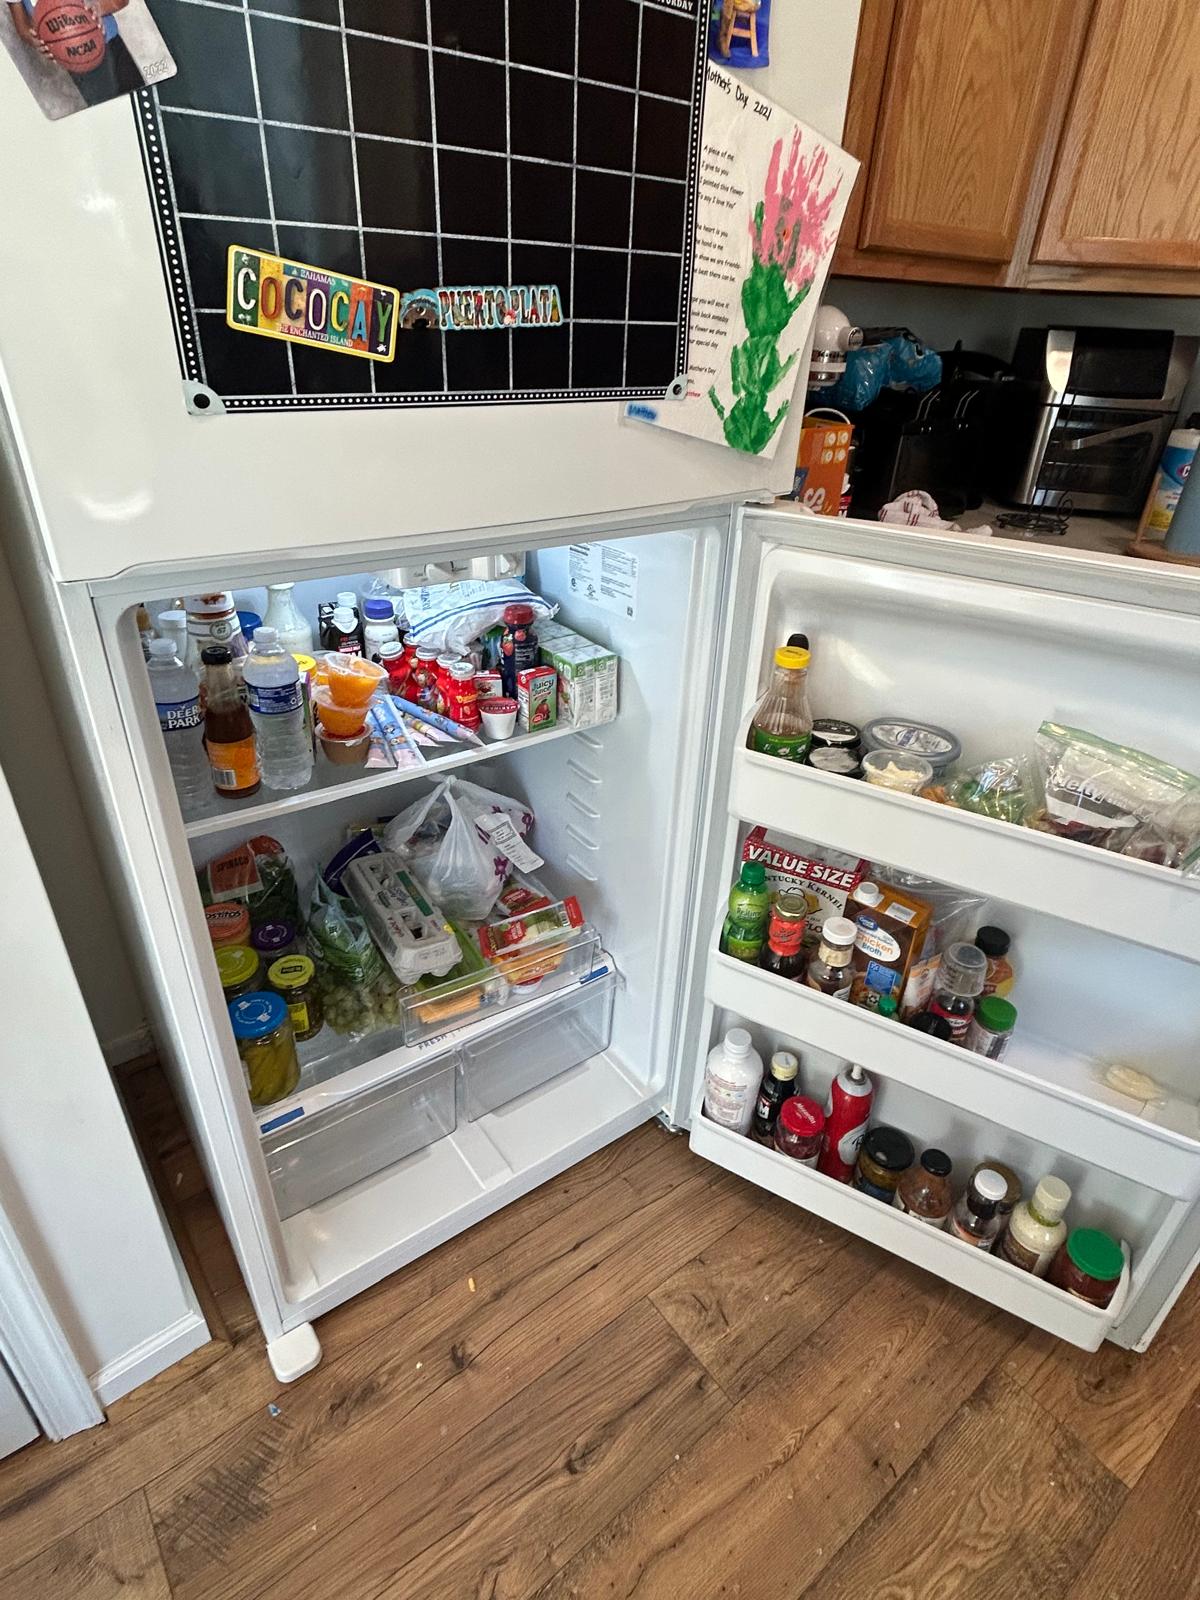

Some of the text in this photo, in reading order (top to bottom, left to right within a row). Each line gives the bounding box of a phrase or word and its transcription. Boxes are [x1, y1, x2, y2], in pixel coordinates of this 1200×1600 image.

[46, 14, 89, 34] Wilson
[65, 39, 97, 57] NCAA
[143, 60, 169, 78] 2022
[735, 84, 749, 110] Day
[753, 101, 772, 121] 2021
[708, 147, 720, 156] piece
[703, 224, 715, 233] heart
[299, 267, 336, 286] BAHAMAS
[237, 267, 393, 343] COCOCAY
[438, 288, 561, 328] PUERTO PLATA
[289, 325, 330, 342] ENCHANTED
[329, 337, 353, 348] ISLAND
[167, 704, 201, 729] DEER PARK
[748, 844, 855, 888] VALUE SIZE
[861, 942, 882, 957] Broth
